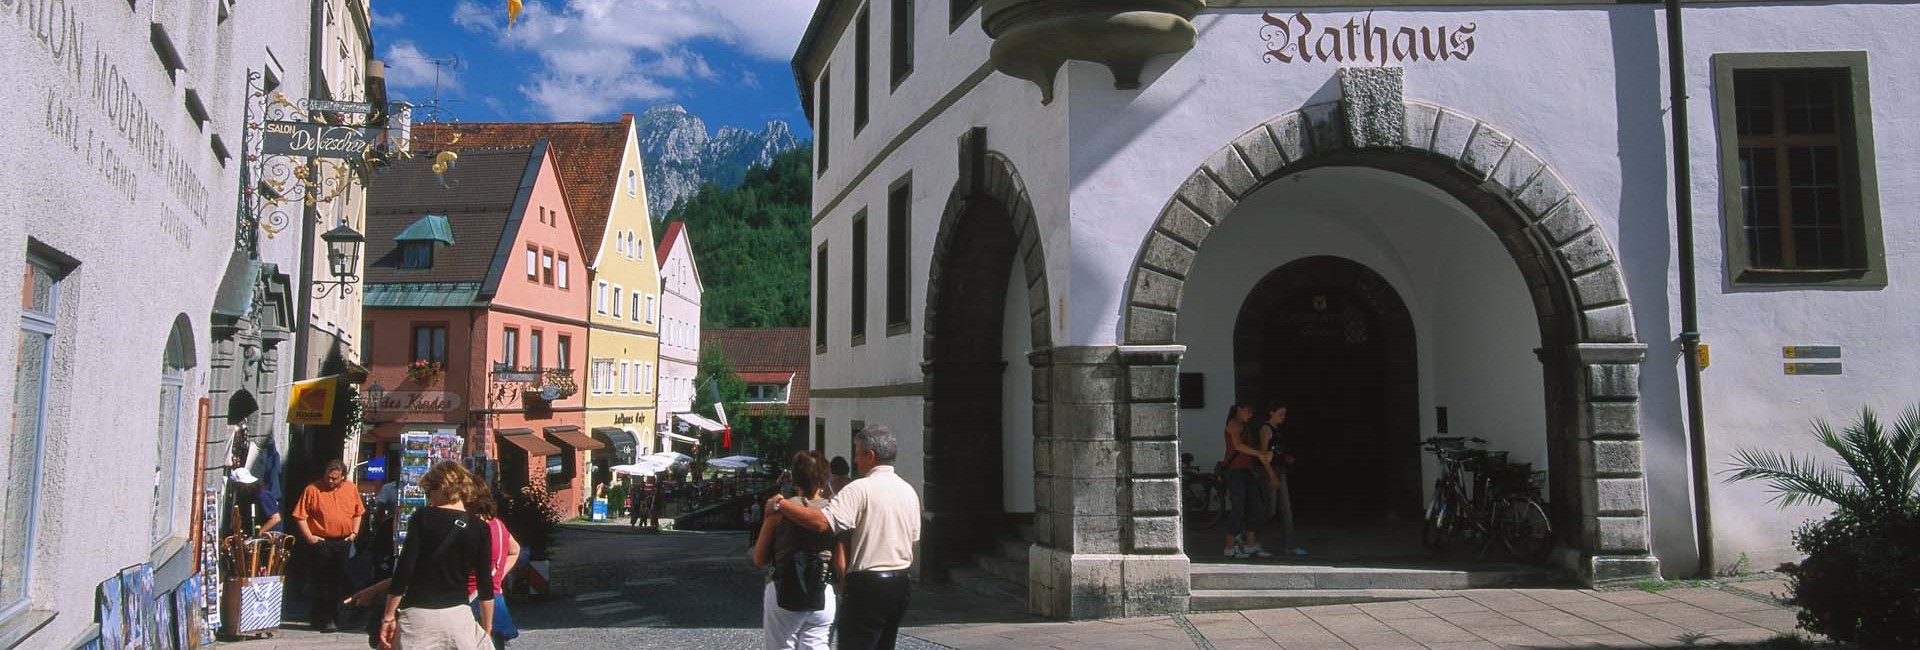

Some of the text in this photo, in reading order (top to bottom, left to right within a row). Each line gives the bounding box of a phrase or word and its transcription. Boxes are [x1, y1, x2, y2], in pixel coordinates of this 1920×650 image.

[1259, 9, 1477, 67] Rathaus
[45, 87, 79, 152] KARL
[98, 140, 137, 201] SCHMID
[92, 41, 164, 175] MODERNER
[267, 123, 296, 134] SALON
